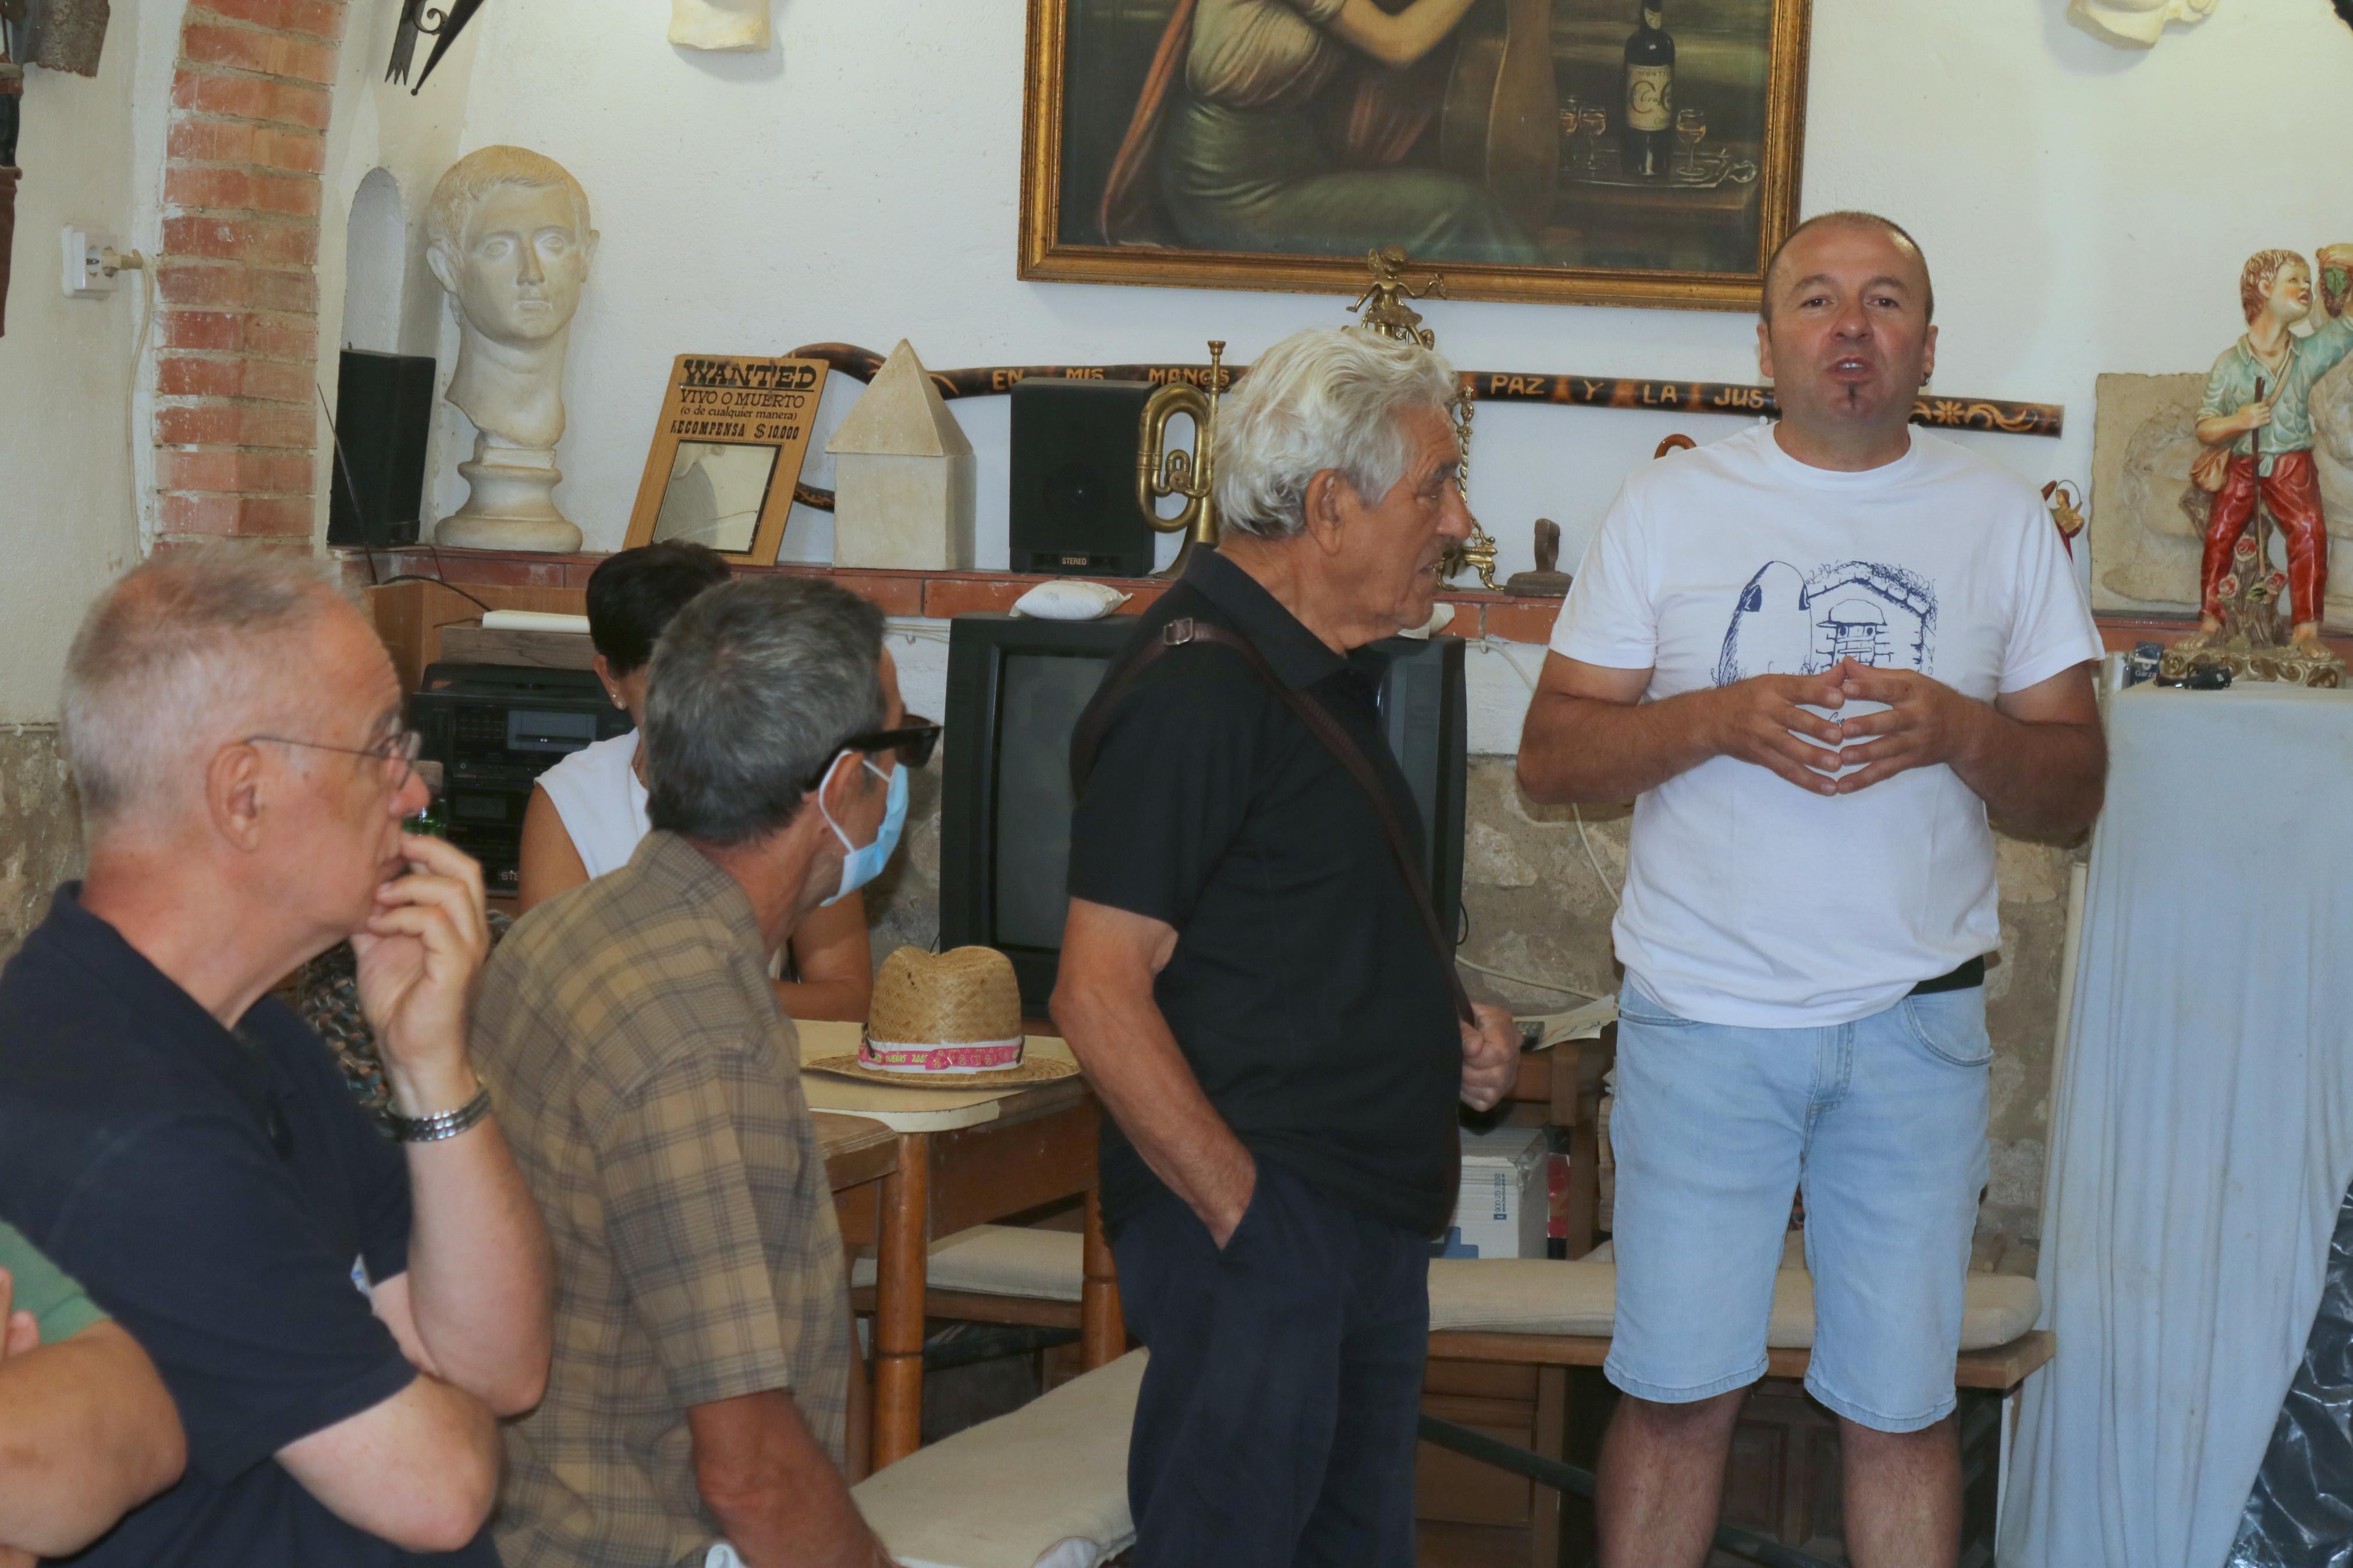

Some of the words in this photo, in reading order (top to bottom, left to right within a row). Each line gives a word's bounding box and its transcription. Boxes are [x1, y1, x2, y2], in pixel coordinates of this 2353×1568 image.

[683, 360, 817, 389] WANTED
[992, 369, 1024, 391] EN
[1490, 376, 1545, 395] PAZ
[1583, 381, 1605, 400] Y
[1644, 384, 1678, 404] LA
[680, 389, 718, 404] VIVO
[721, 392, 733, 405] O
[736, 393, 805, 409] MUERTO
[680, 406, 690, 416] (o
[694, 405, 706, 415] de
[708, 407, 753, 419] cualquier
[755, 410, 797, 421] manera)
[670, 420, 746, 438] RECOMPENSA
[754, 423, 766, 439] $
[768, 425, 800, 440] 10.000
[1062, 557, 1087, 566] STEREO
[2135, 670, 2157, 678] Garza
